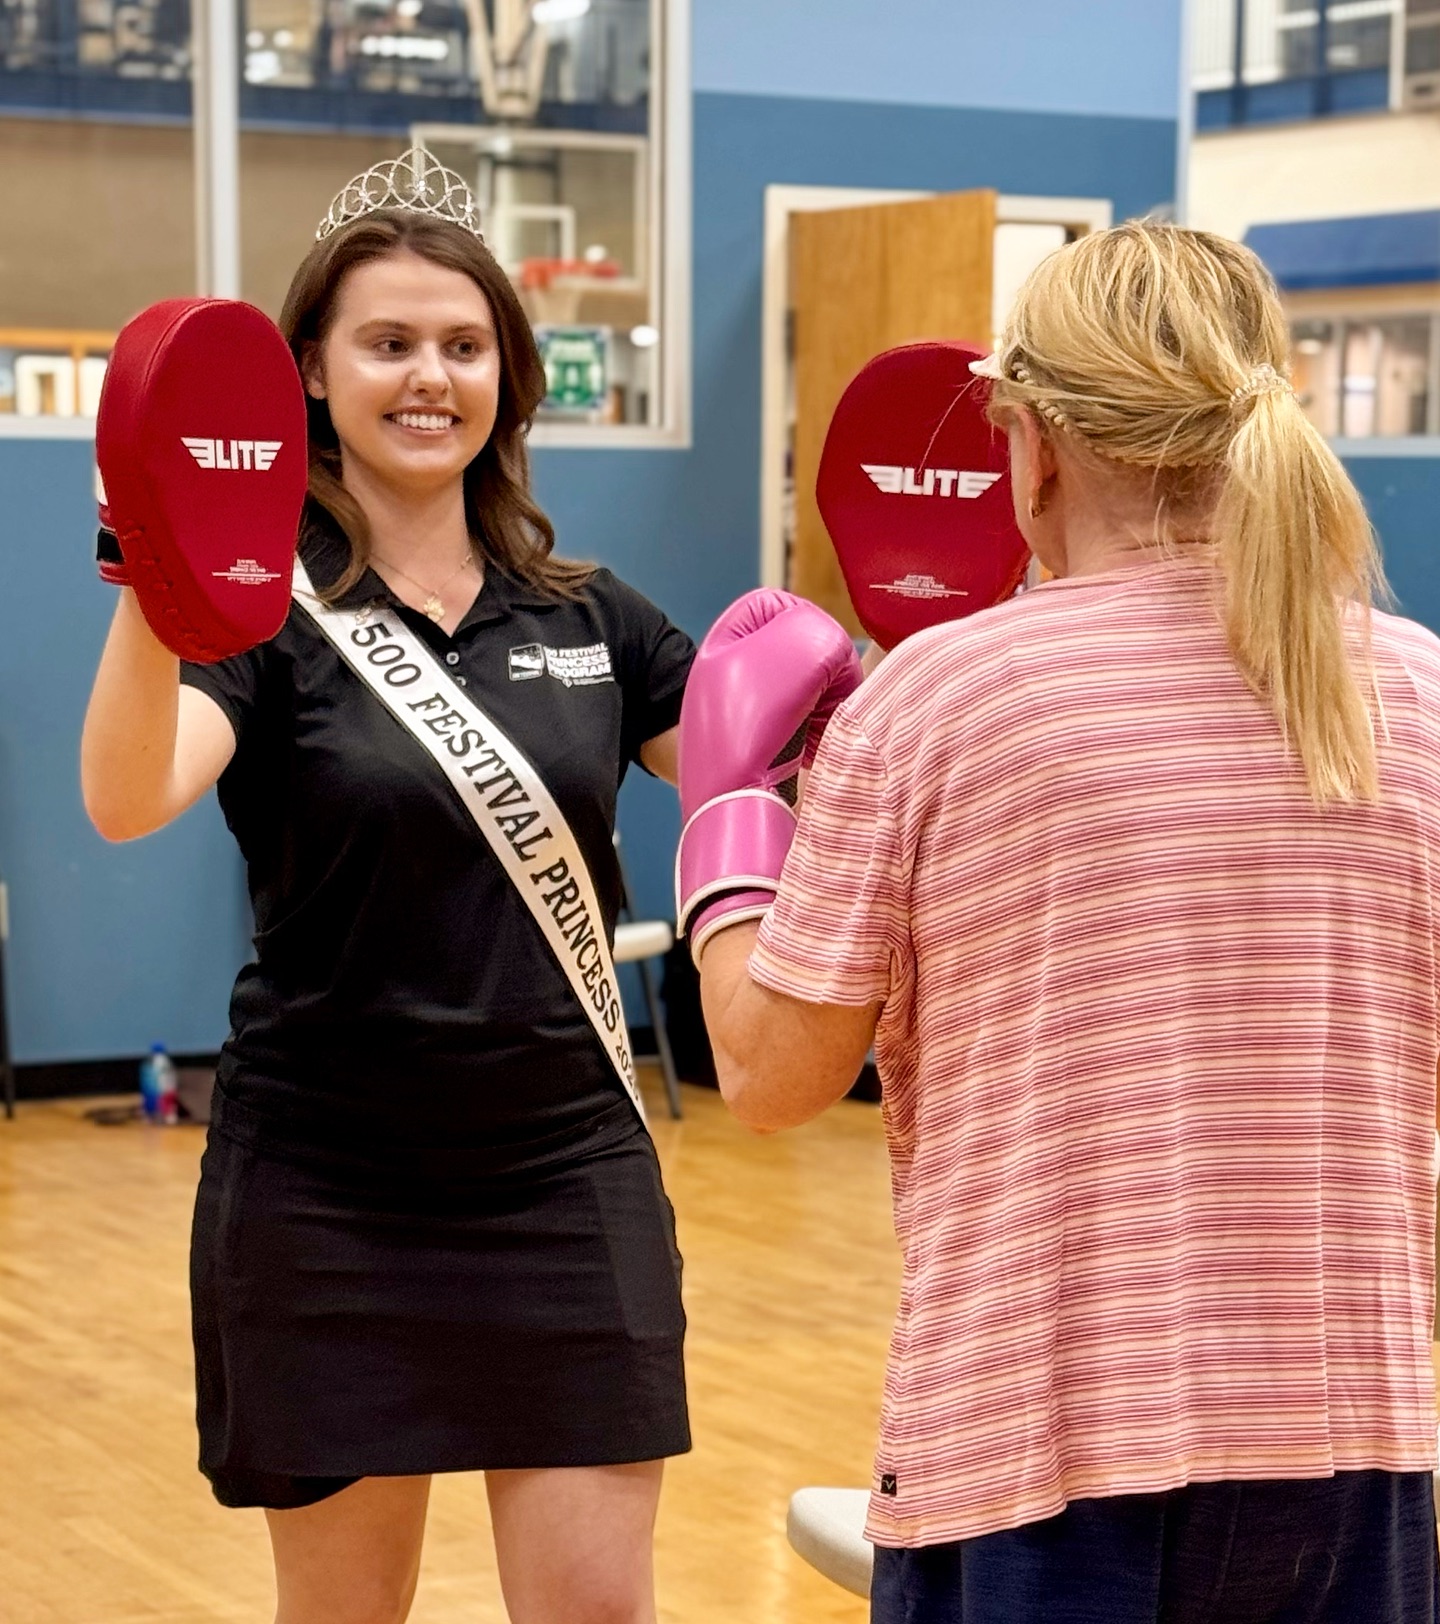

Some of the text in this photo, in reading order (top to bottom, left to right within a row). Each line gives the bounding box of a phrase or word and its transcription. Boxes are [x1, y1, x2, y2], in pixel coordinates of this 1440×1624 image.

[181, 437, 283, 470] ELITE
[861, 464, 1002, 498] ELITE
[559, 643, 608, 657] FESTIVAL
[351, 622, 638, 1101] 500 FESTIVAL PRINCESS 202
